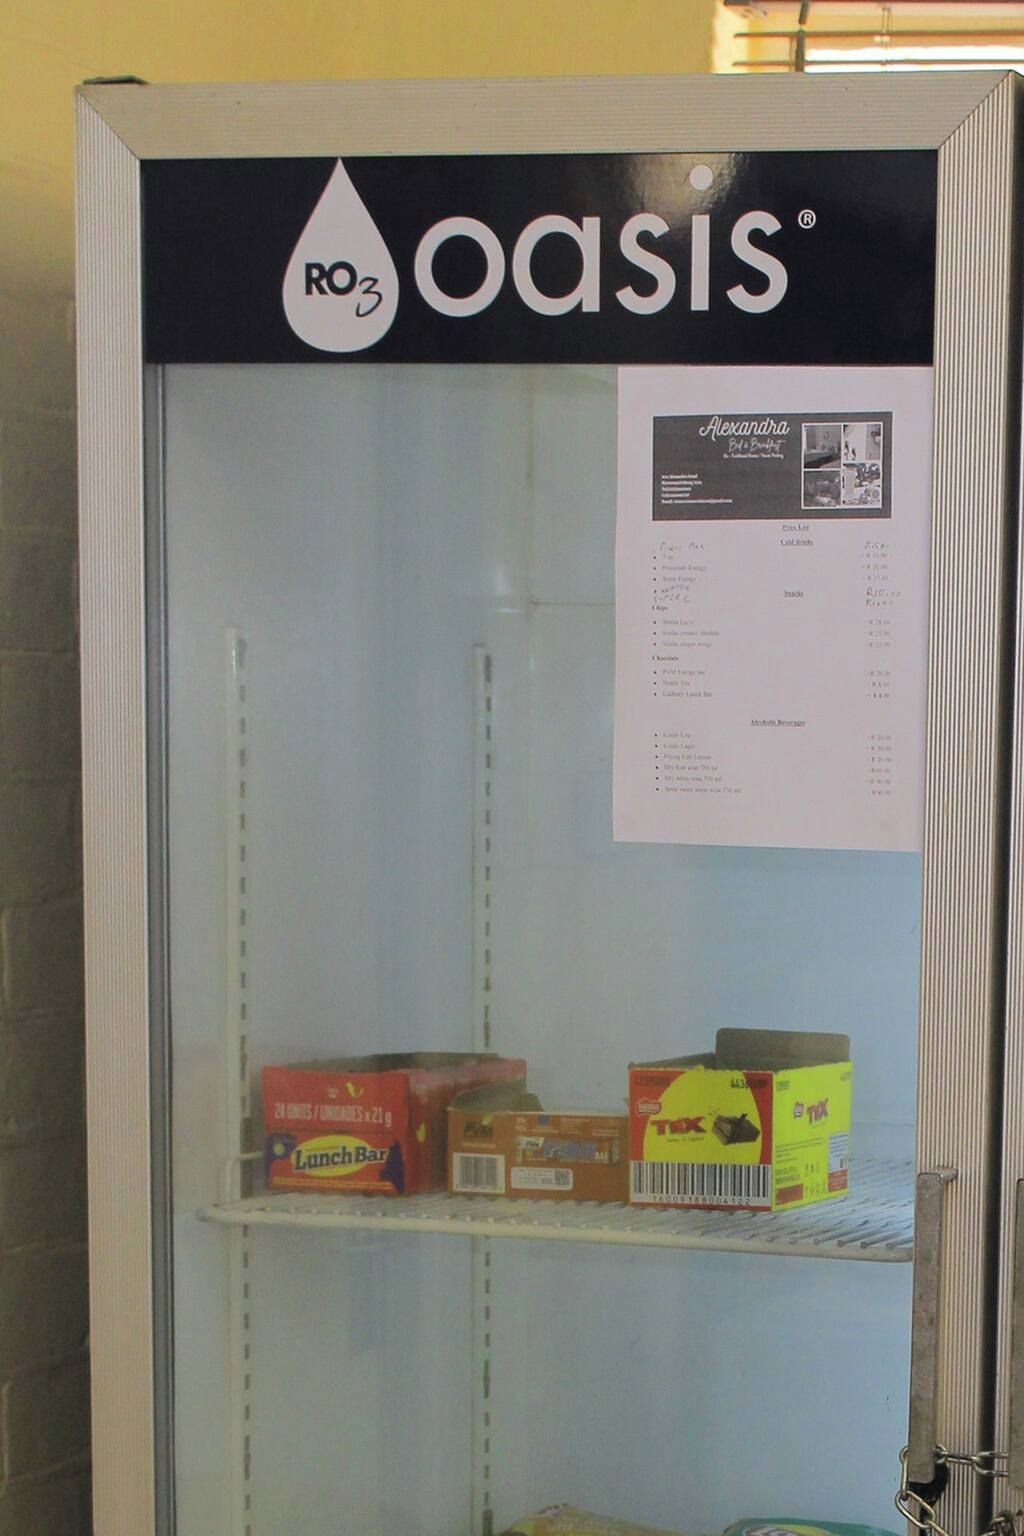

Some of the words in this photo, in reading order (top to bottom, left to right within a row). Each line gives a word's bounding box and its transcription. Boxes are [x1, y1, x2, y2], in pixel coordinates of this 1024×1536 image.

[414, 164, 788, 318] oasis
[699, 416, 790, 442] Alexandra
[295, 1145, 353, 1172] Lunch
[354, 1146, 390, 1165] Bar
